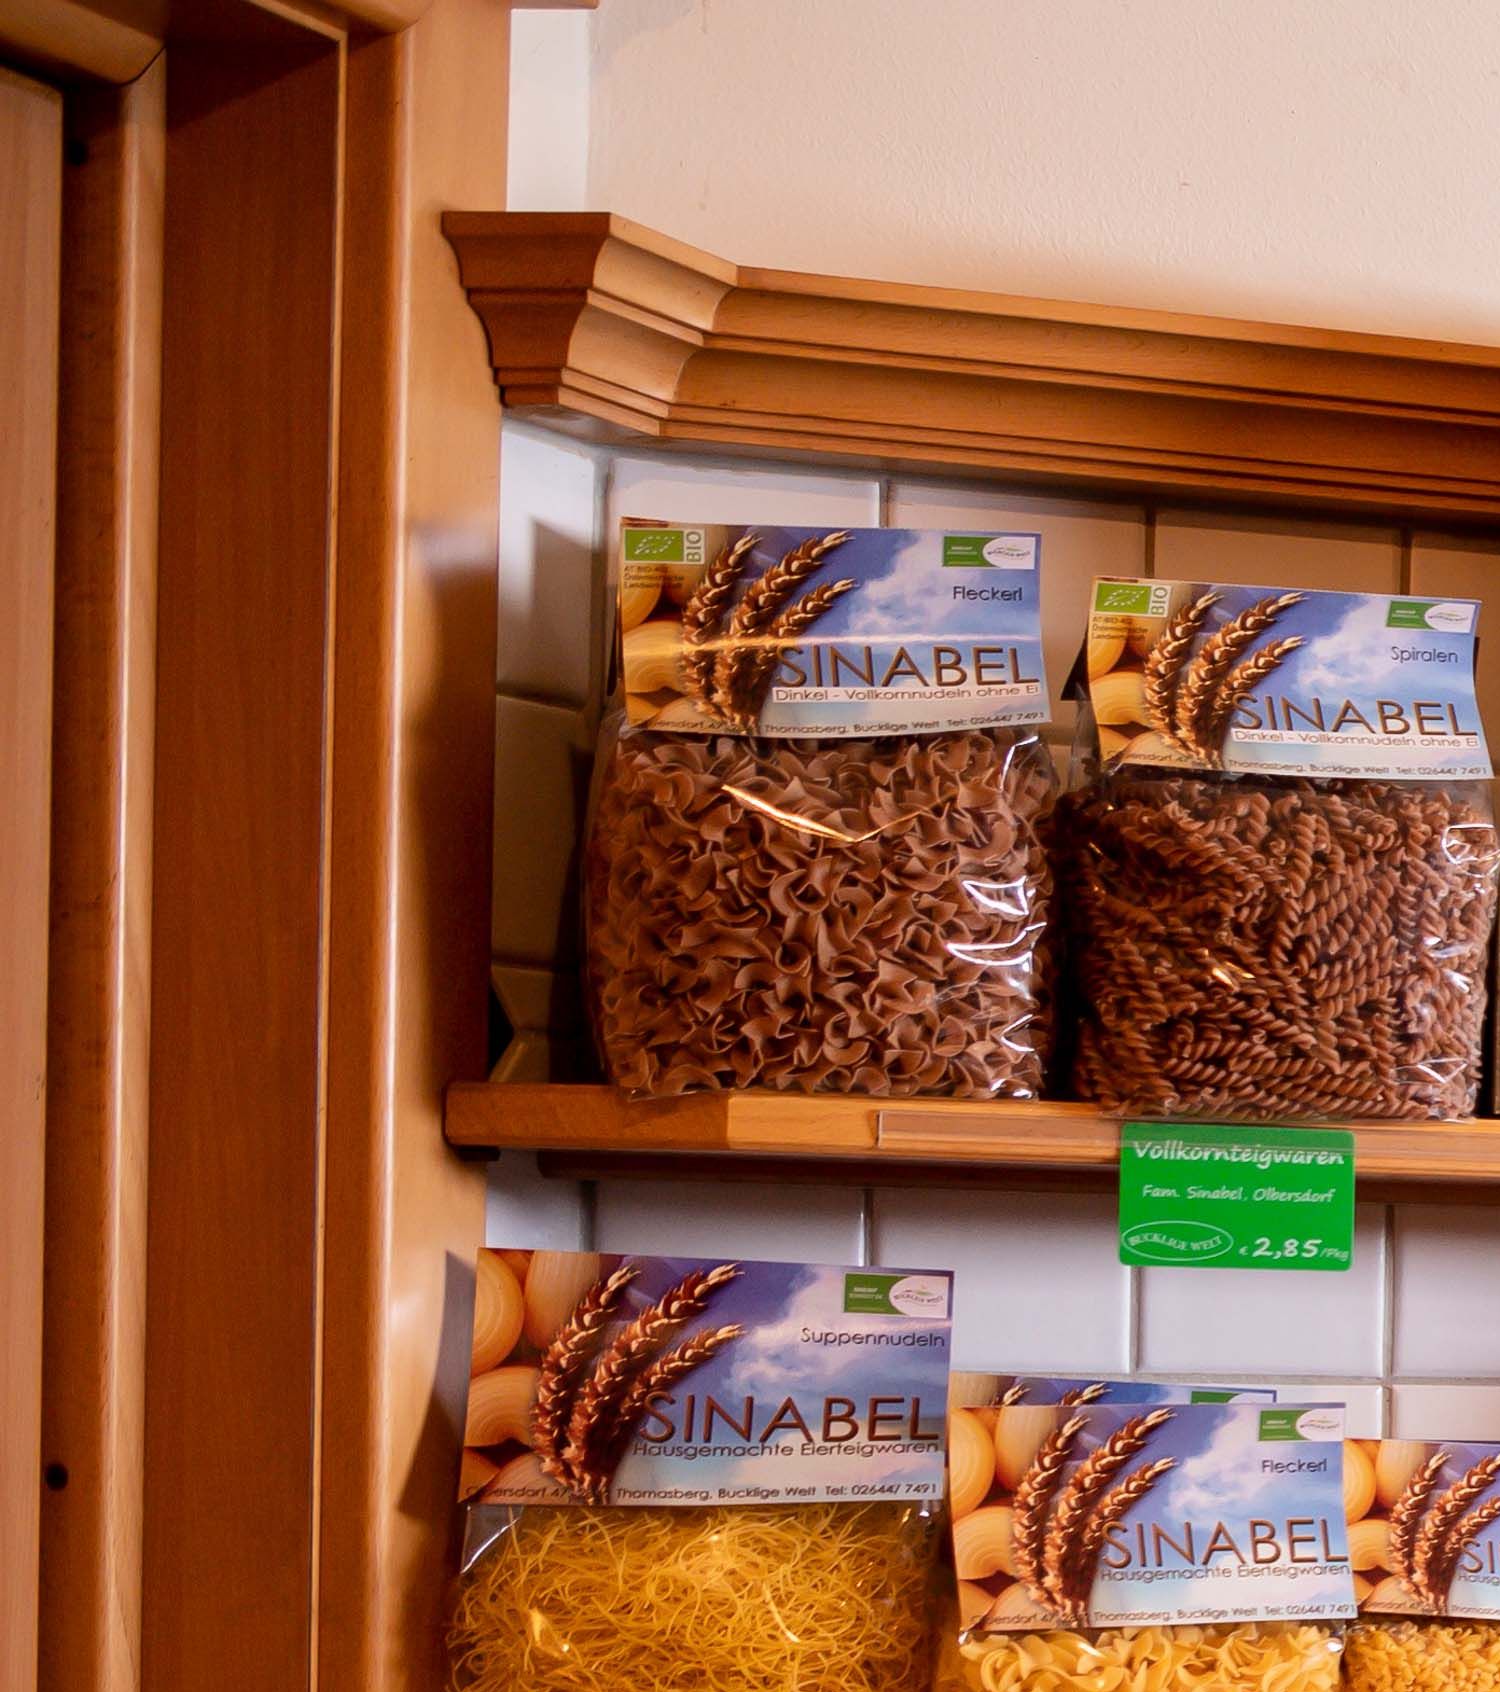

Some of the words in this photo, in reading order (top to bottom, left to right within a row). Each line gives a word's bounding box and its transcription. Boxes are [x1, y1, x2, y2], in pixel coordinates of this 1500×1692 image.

[953, 586, 1022, 601] Fleckerl
[1391, 647, 1458, 663] Spiralen
[776, 645, 1040, 688] SINABEL
[775, 689, 829, 702] Dinkel
[1233, 694, 1478, 736] SINABEL
[1133, 1140, 1344, 1169] Vollkornteigwaren
[801, 1327, 944, 1347] Suppennudeln
[640, 1392, 939, 1443] SINABEL
[633, 1442, 793, 1459] Hausgemachte
[801, 1440, 939, 1457] Eierteigwaren
[1262, 1459, 1327, 1473] Fleckerl
[1102, 1518, 1348, 1568] SINABEL
